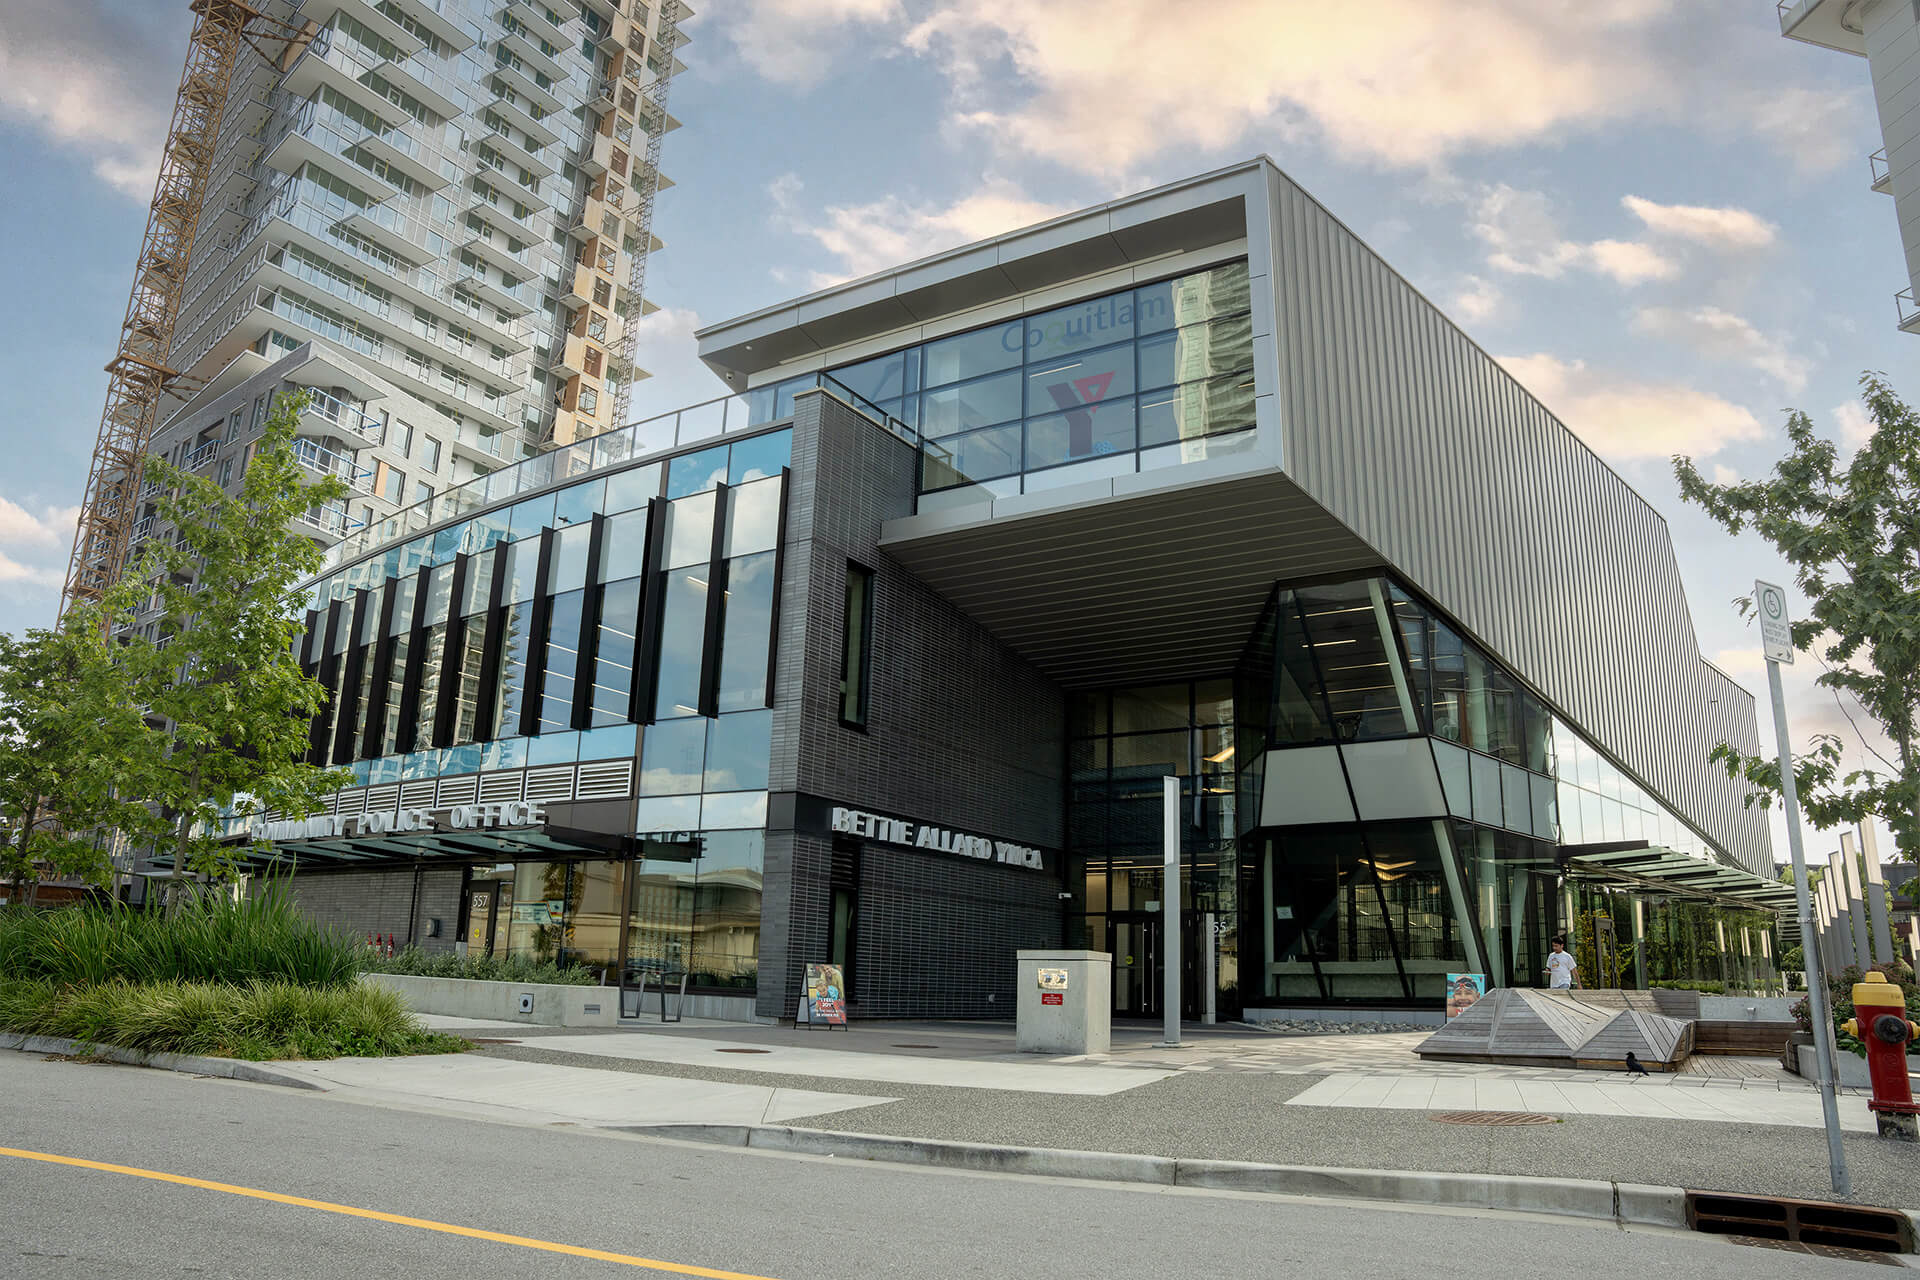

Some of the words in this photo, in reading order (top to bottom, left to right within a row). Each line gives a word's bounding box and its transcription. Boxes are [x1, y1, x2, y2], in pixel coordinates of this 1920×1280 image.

[357, 807, 438, 834] POLICE
[451, 800, 547, 829] OFFICE
[832, 806, 914, 846] BETTIE
[915, 825, 993, 860] ALLARD
[995, 841, 1044, 870] YMCA
[472, 895, 488, 907] 557
